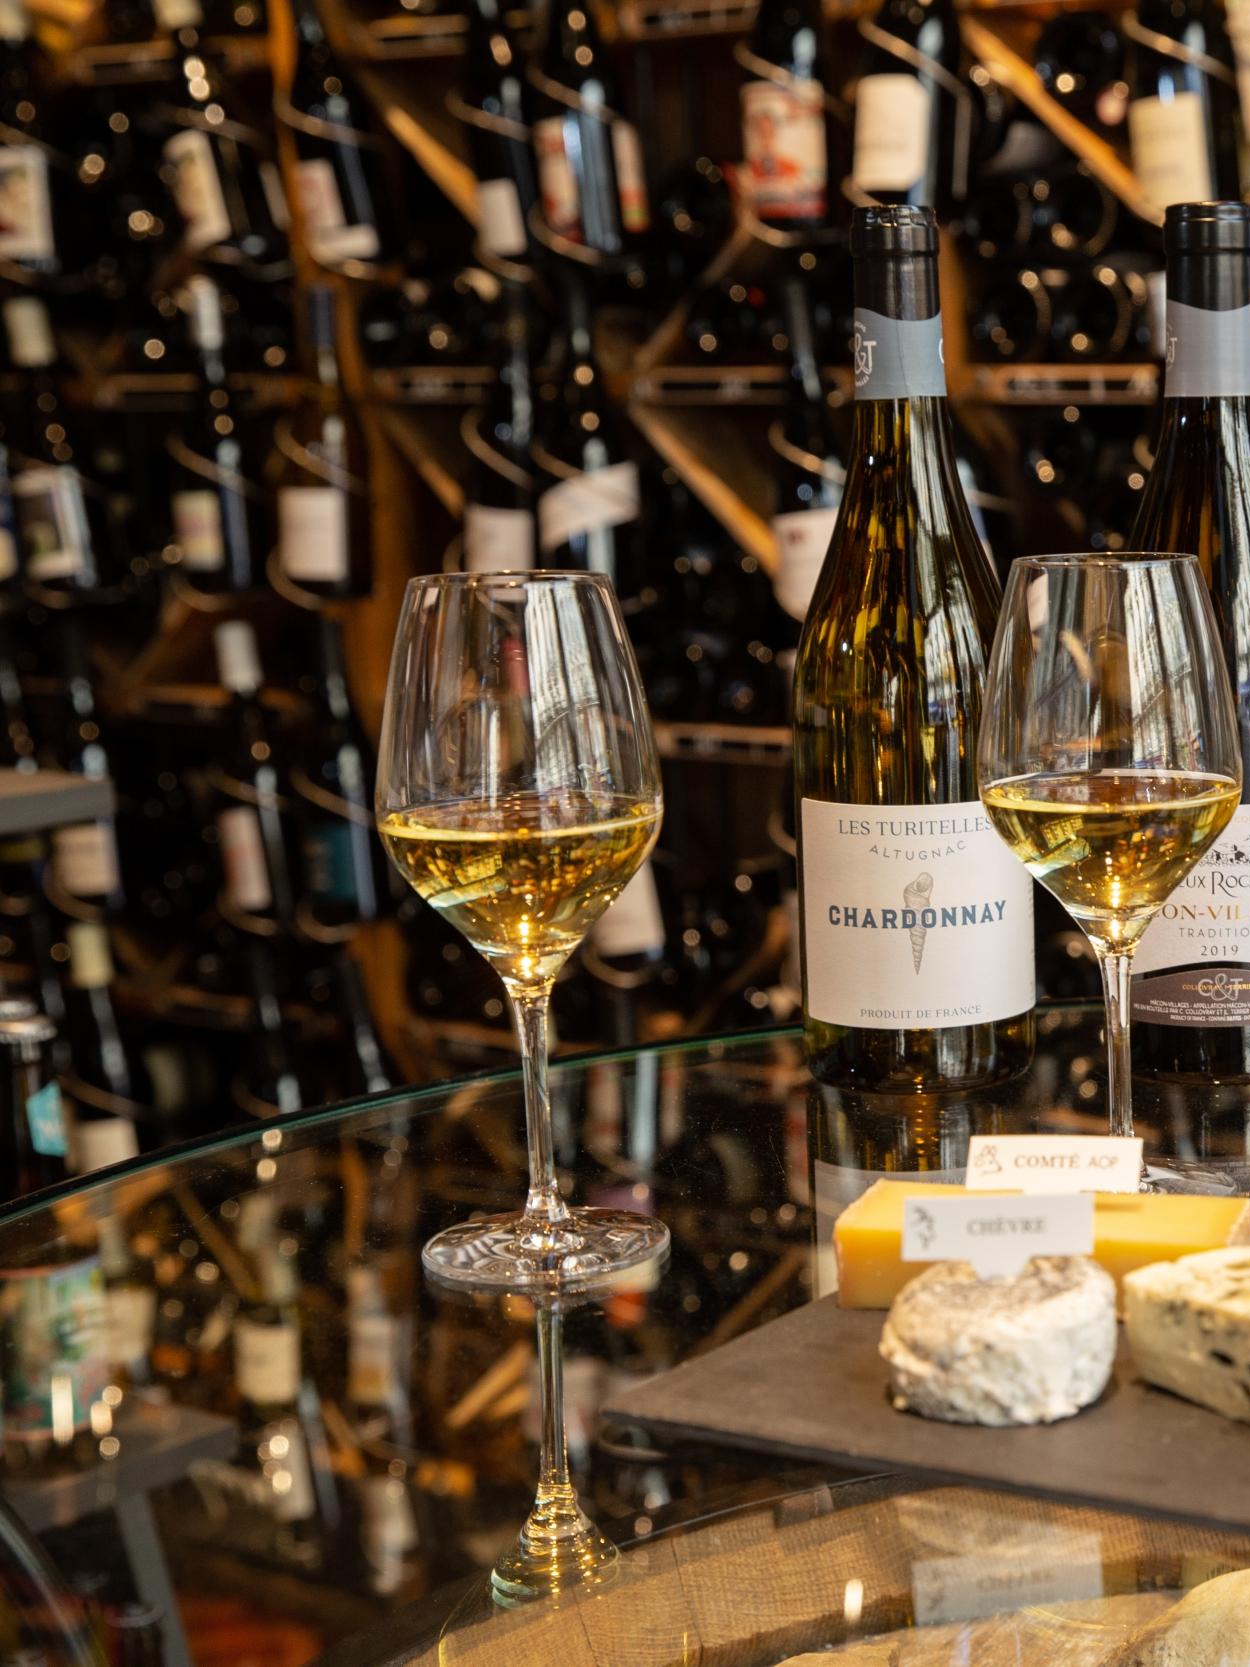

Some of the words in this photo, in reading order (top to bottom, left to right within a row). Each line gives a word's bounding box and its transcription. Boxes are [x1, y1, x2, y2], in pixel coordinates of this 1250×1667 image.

[838, 819, 870, 836] LES
[876, 816, 993, 836] TURITELLES
[869, 840, 967, 861] ALTUGNAC
[1178, 874, 1206, 889] UX
[828, 900, 1006, 929] CHARDONNAY
[1200, 945, 1239, 957] 2019
[860, 1008, 913, 1020] PRODUIT
[916, 1009, 932, 1019] DE
[935, 1004, 983, 1018] FRANCE
[1013, 1153, 1080, 1169] COMTÉ
[1087, 1155, 1119, 1169] AOP
